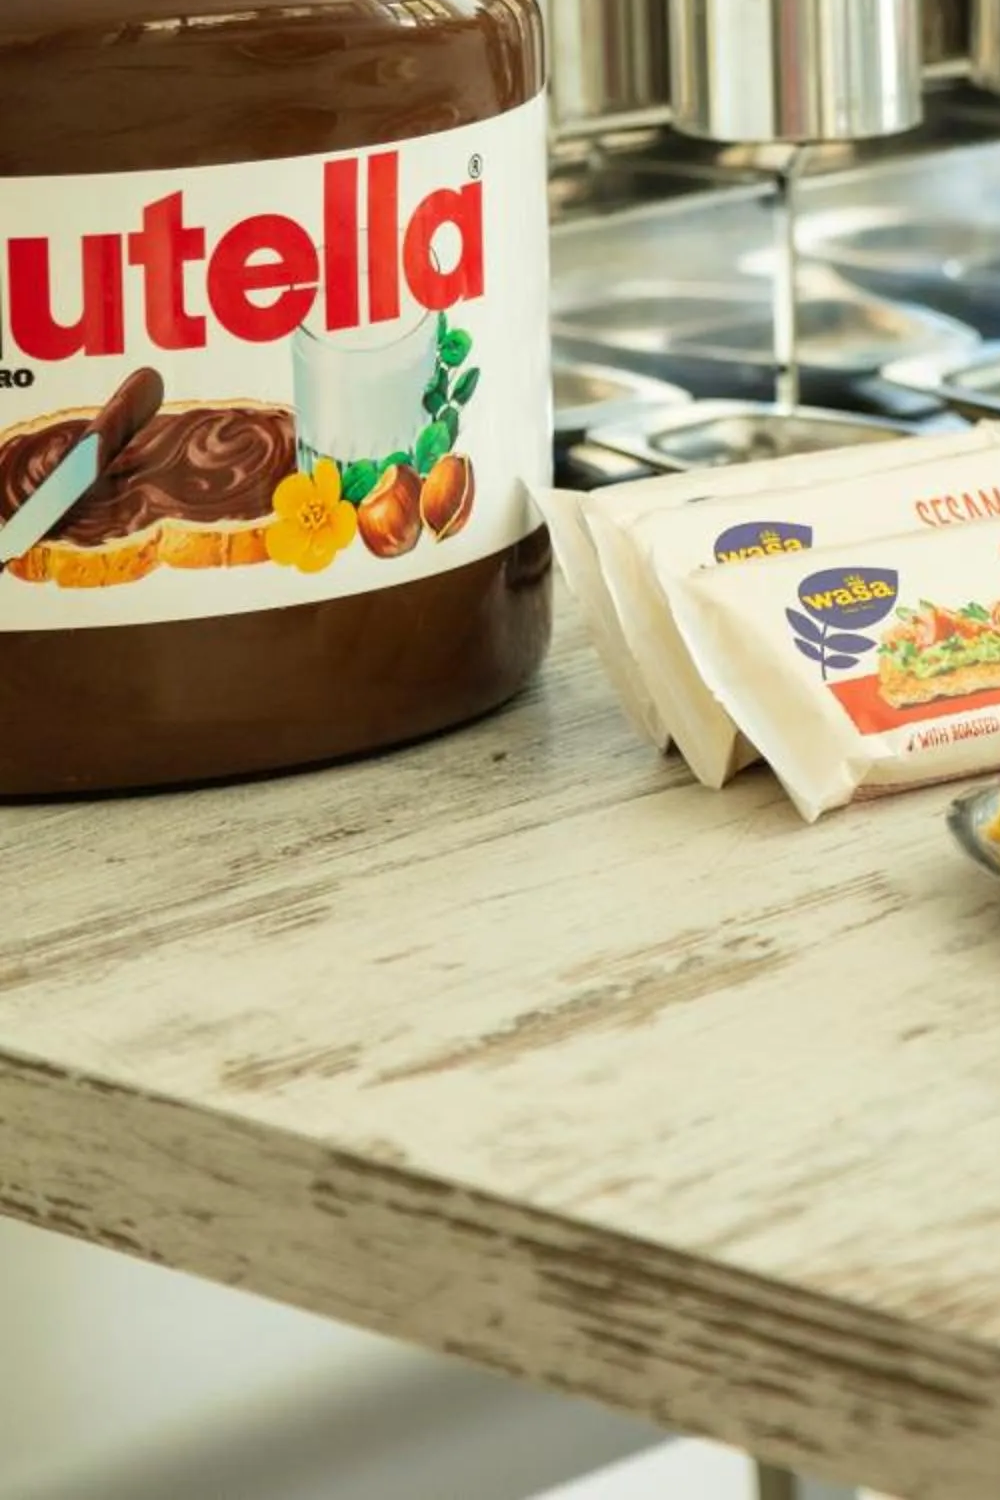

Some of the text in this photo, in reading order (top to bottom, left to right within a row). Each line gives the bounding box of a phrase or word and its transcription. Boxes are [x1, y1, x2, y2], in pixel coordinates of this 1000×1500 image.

[0, 150, 485, 361] utella
[802, 580, 891, 611] wasa
[917, 729, 950, 750] WITH
[951, 717, 1000, 741] ROASTED
